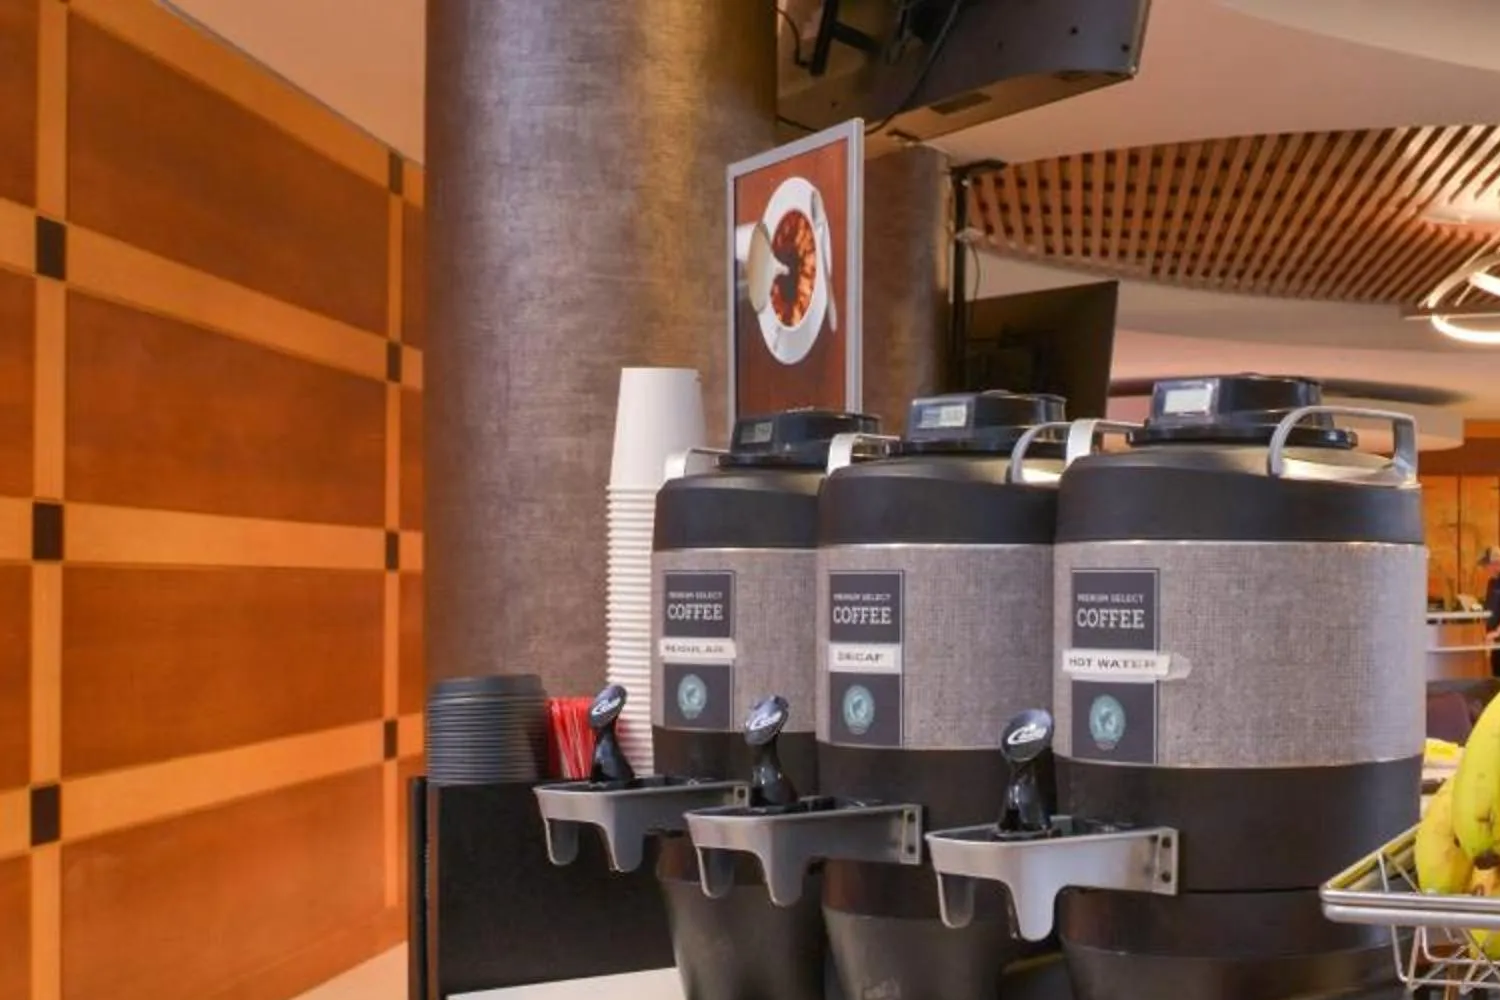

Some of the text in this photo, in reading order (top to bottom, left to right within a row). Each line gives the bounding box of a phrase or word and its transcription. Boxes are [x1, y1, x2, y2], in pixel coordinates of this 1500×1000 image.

[667, 603, 724, 620] COFFEE
[833, 606, 892, 624] COFFEE
[1077, 608, 1145, 629] COFFEE
[837, 651, 884, 662] DECAF
[1069, 656, 1093, 668] HOT
